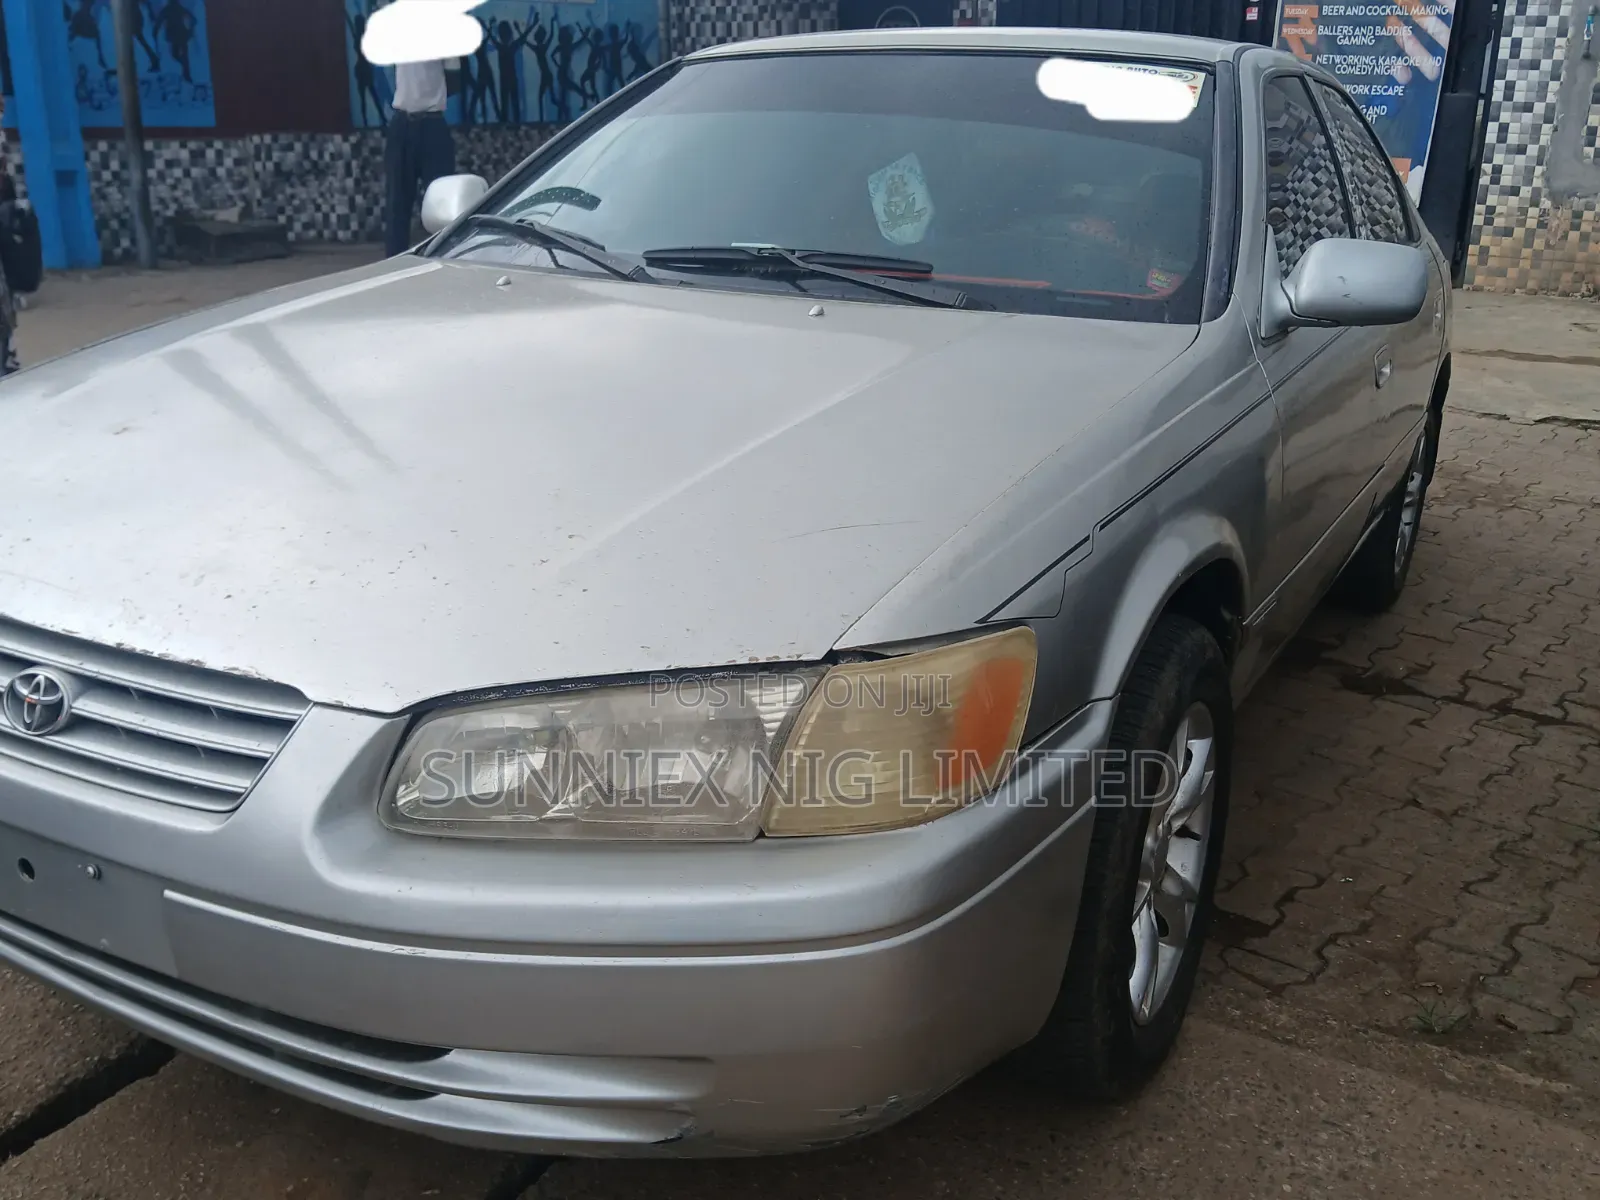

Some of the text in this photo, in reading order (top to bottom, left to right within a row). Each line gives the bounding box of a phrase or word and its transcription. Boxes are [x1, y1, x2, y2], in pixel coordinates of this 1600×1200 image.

[1322, 5, 1449, 16] BEER AND COCKTAIL MAKING
[1317, 25, 1413, 36] BALLERS AND BADDIES
[1336, 35, 1376, 45] GAMING
[1315, 54, 1376, 66] NETWORKING
[1378, 55, 1420, 66] KARAOKE
[1334, 64, 1404, 76] COMEDY NIGHT
[1371, 85, 1405, 96] ESCAPE
[1367, 104, 1388, 115] AND
